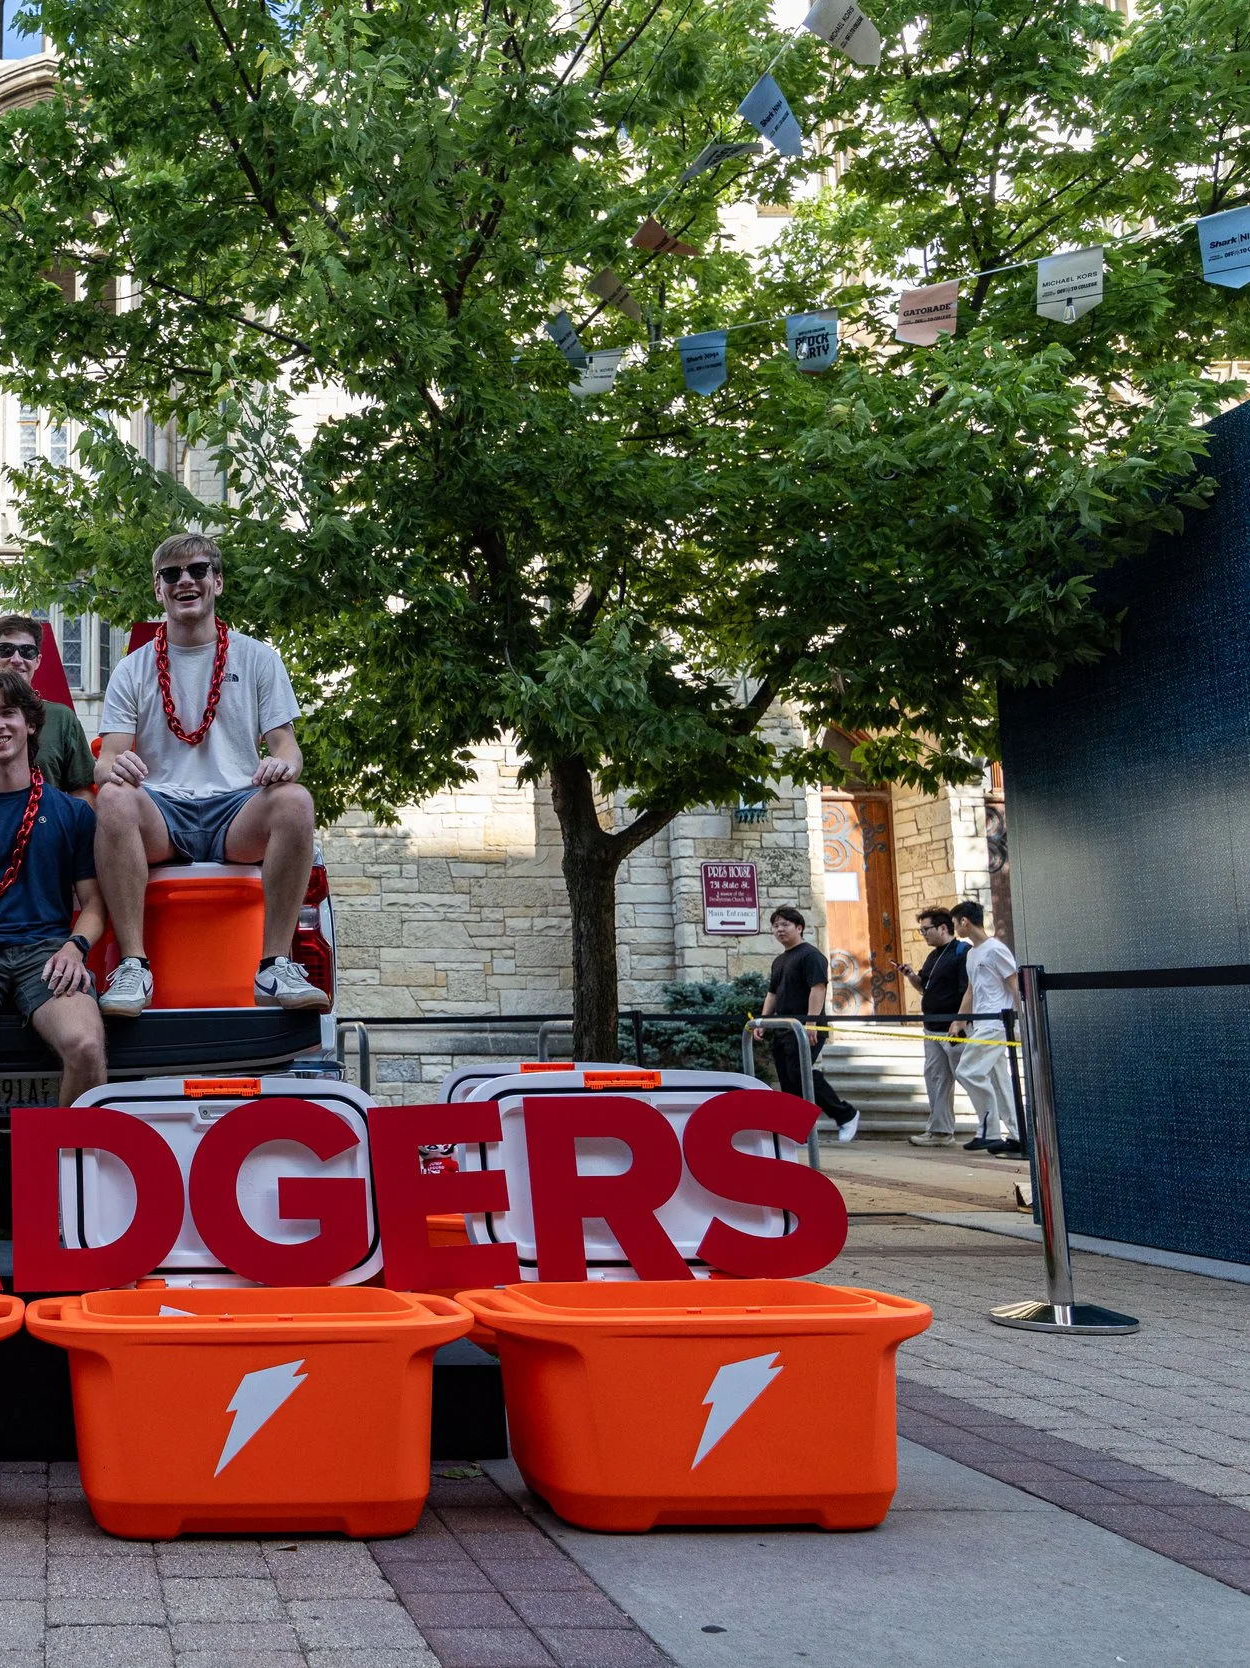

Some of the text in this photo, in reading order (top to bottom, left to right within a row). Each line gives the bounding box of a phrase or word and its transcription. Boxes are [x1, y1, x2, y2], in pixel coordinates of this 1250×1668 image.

[841, 6, 855, 22] KORS
[1210, 236, 1238, 249] Shark
[1042, 271, 1098, 288] MICHAEL KORS
[903, 303, 952, 316] GATORADE
[795, 332, 829, 349] BOCK
[796, 344, 830, 361] RTY
[708, 866, 751, 878] PRES HOUSE
[710, 881, 750, 889] 731 State St.
